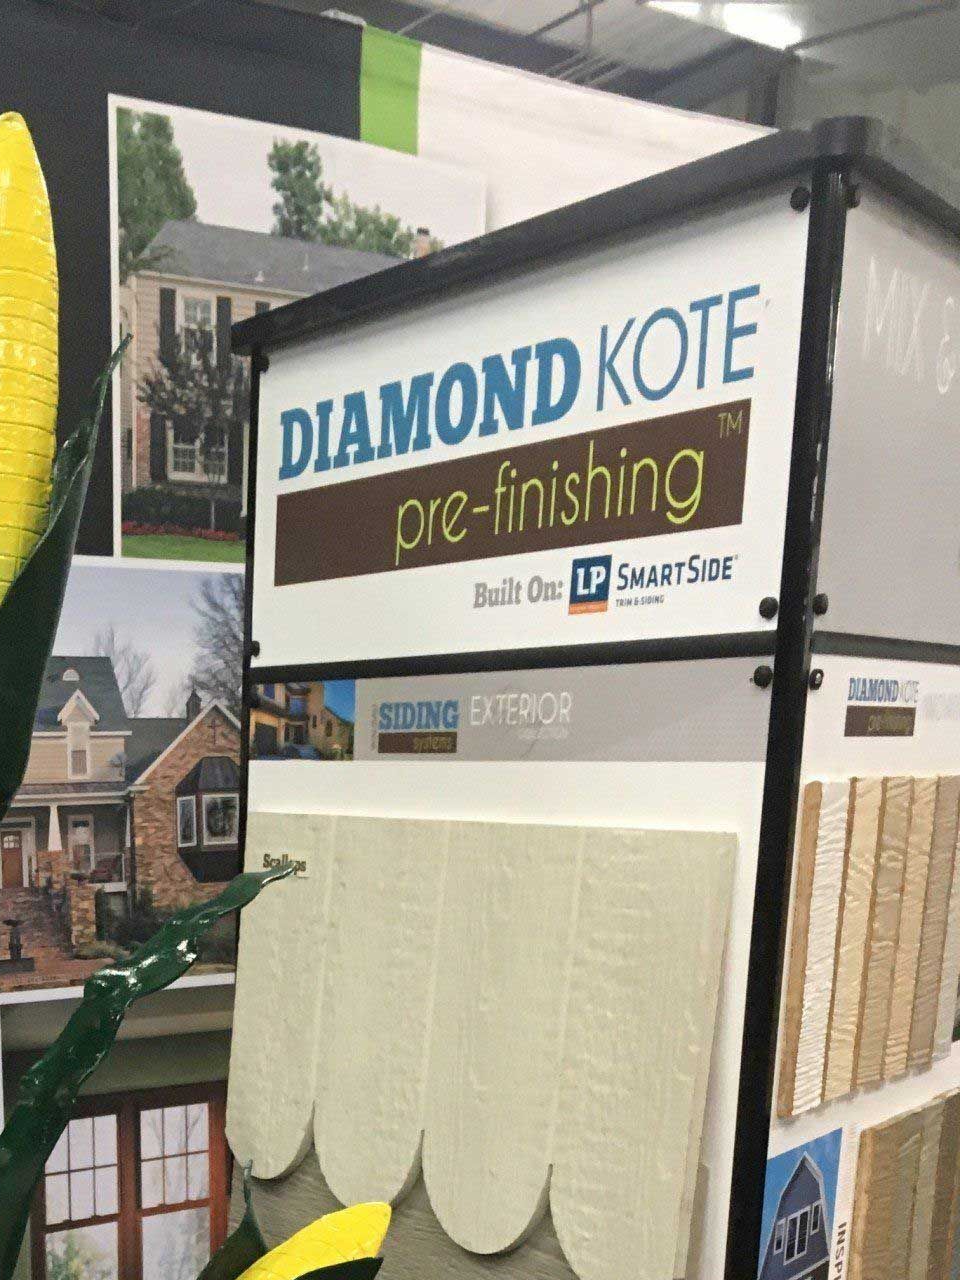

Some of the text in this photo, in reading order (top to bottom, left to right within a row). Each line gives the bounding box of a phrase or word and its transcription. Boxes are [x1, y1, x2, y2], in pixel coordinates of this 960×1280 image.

[278, 284, 761, 481] DIAMOND KOTE
[394, 440, 705, 566] pre-finishing
[473, 575, 564, 608] Built On:
[576, 565, 606, 596] LP
[847, 677, 899, 703] DIAMOND
[379, 699, 460, 729] SIDING
[469, 691, 573, 726] EXTERIOR
[262, 853, 307, 875] Scallps
